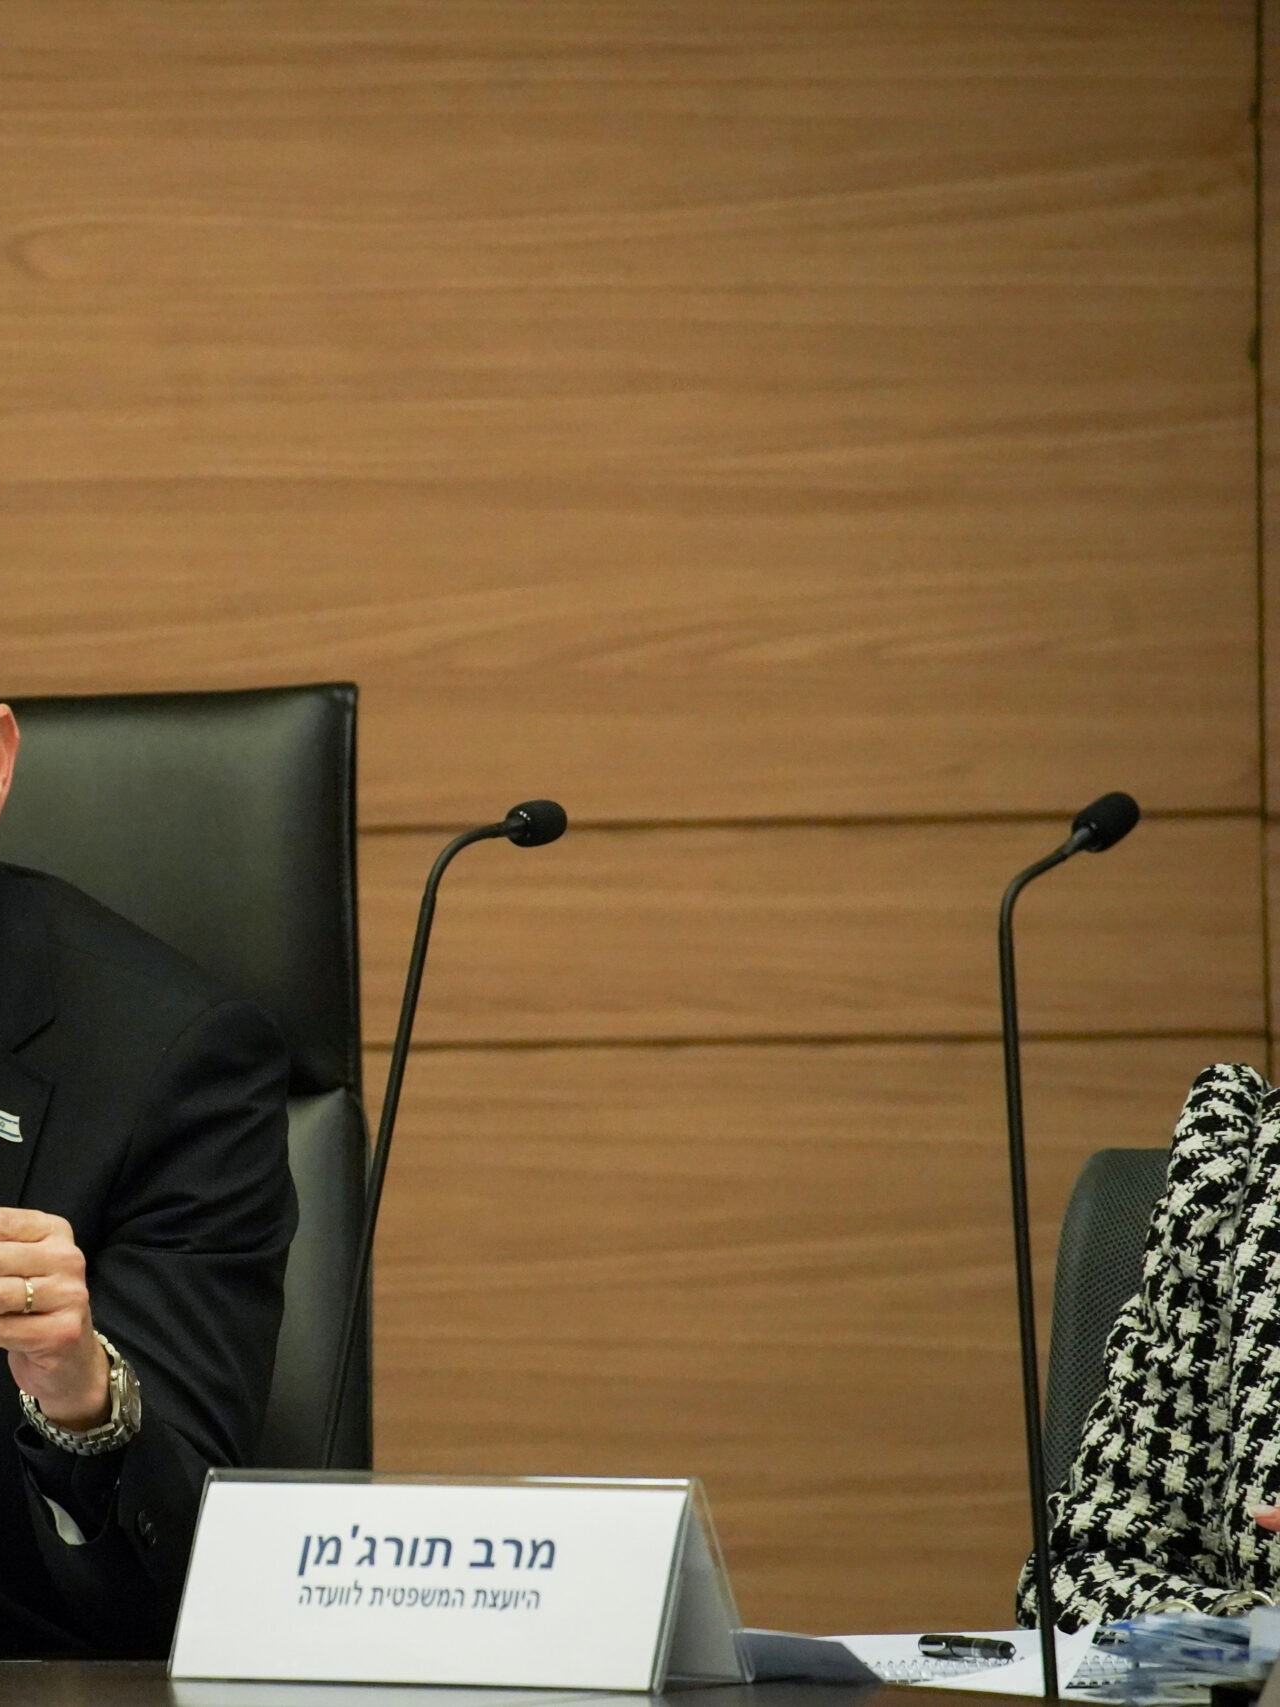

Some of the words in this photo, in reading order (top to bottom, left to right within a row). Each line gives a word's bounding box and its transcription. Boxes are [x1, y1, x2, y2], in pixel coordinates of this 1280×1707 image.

[297, 1524, 453, 1576] תורג'מן
[468, 1537, 556, 1570] מרב
[297, 1580, 364, 1607] לוועדה
[368, 1586, 466, 1608] המשפטית
[472, 1588, 541, 1611] היועצת
